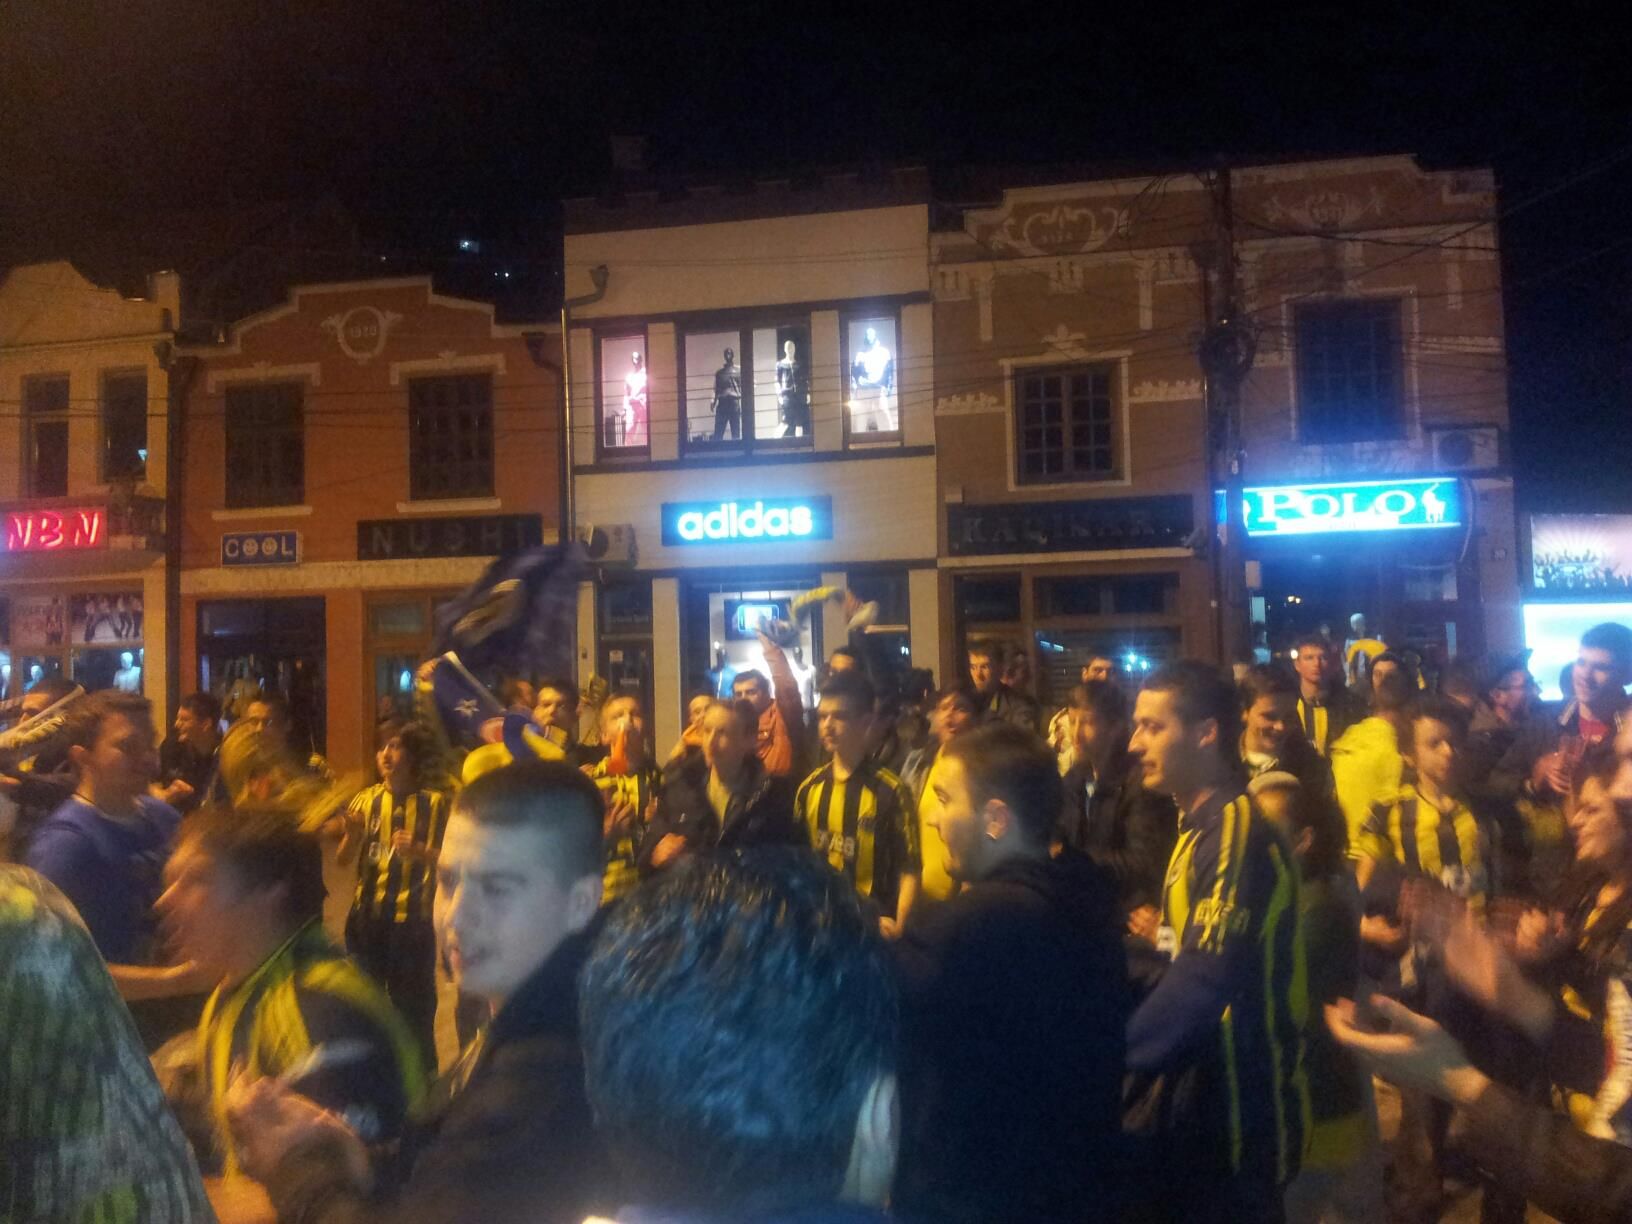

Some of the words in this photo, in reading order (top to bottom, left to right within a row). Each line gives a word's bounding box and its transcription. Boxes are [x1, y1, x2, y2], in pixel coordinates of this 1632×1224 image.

[678, 501, 813, 540] adidas
[1257, 489, 1416, 522] POLO
[225, 536, 294, 557] COOL
